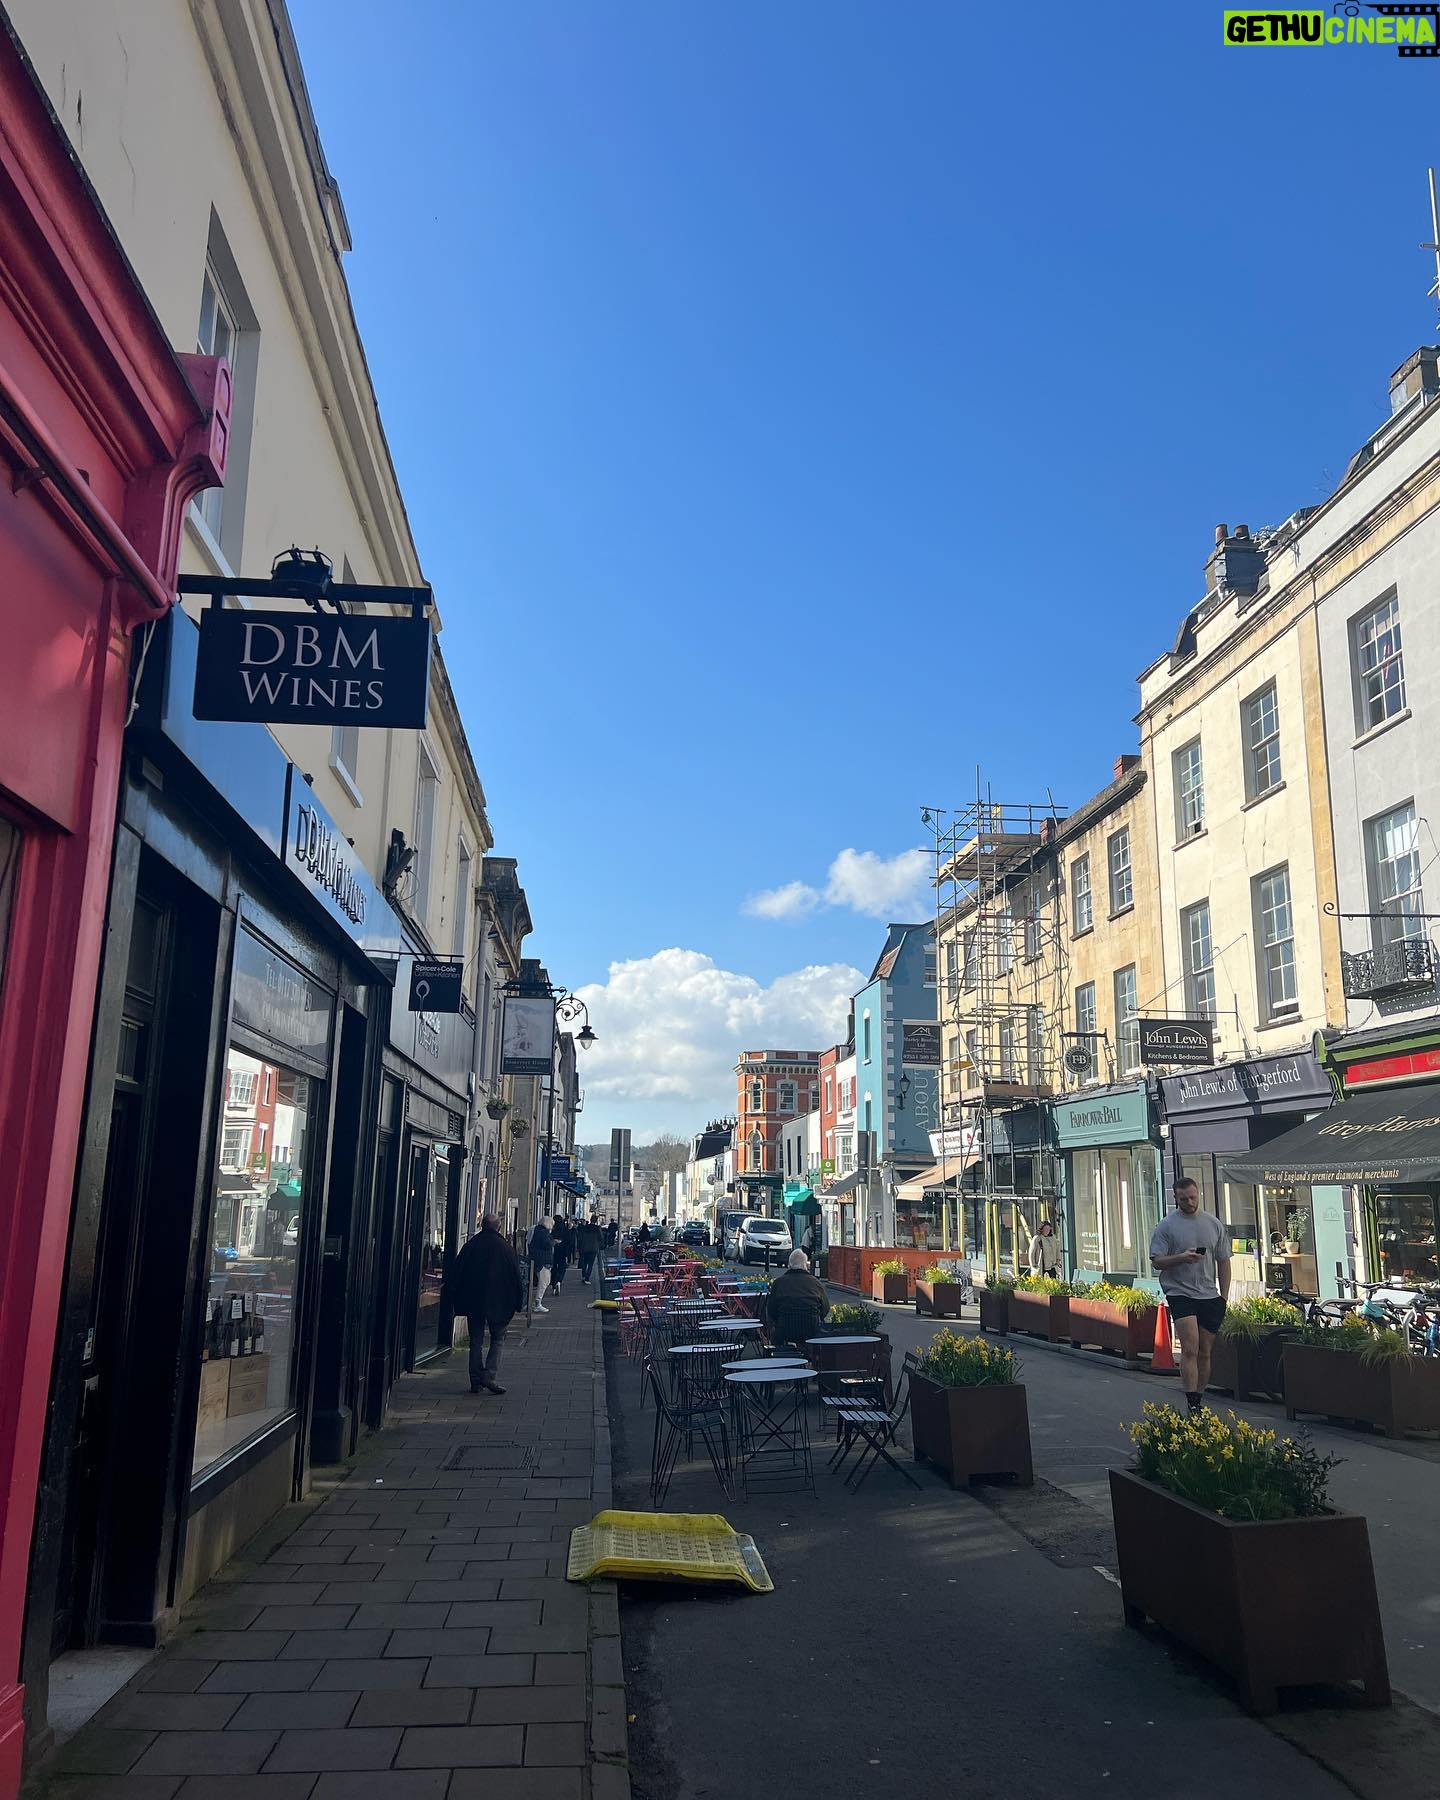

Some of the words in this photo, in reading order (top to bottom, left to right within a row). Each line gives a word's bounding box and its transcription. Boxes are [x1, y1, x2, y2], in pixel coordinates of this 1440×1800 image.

[240, 622, 385, 671] DBM
[1144, 1031, 1171, 1046] John
[1174, 1032, 1208, 1045] Lewis
[1147, 1052, 1172, 1060] Kitchens
[1179, 1053, 1208, 1061] Bedrooms
[1199, 1078, 1226, 1096] Lewis
[1227, 1071, 1239, 1092] of
[1238, 1061, 1301, 1092] Hungerford
[1264, 1170, 1278, 1181] West
[1278, 1170, 1283, 1184] of
[1284, 1170, 1311, 1184] England's
[1310, 1170, 1335, 1184] premier
[1335, 1169, 1363, 1180] diamond
[1364, 1167, 1400, 1179] merchants
